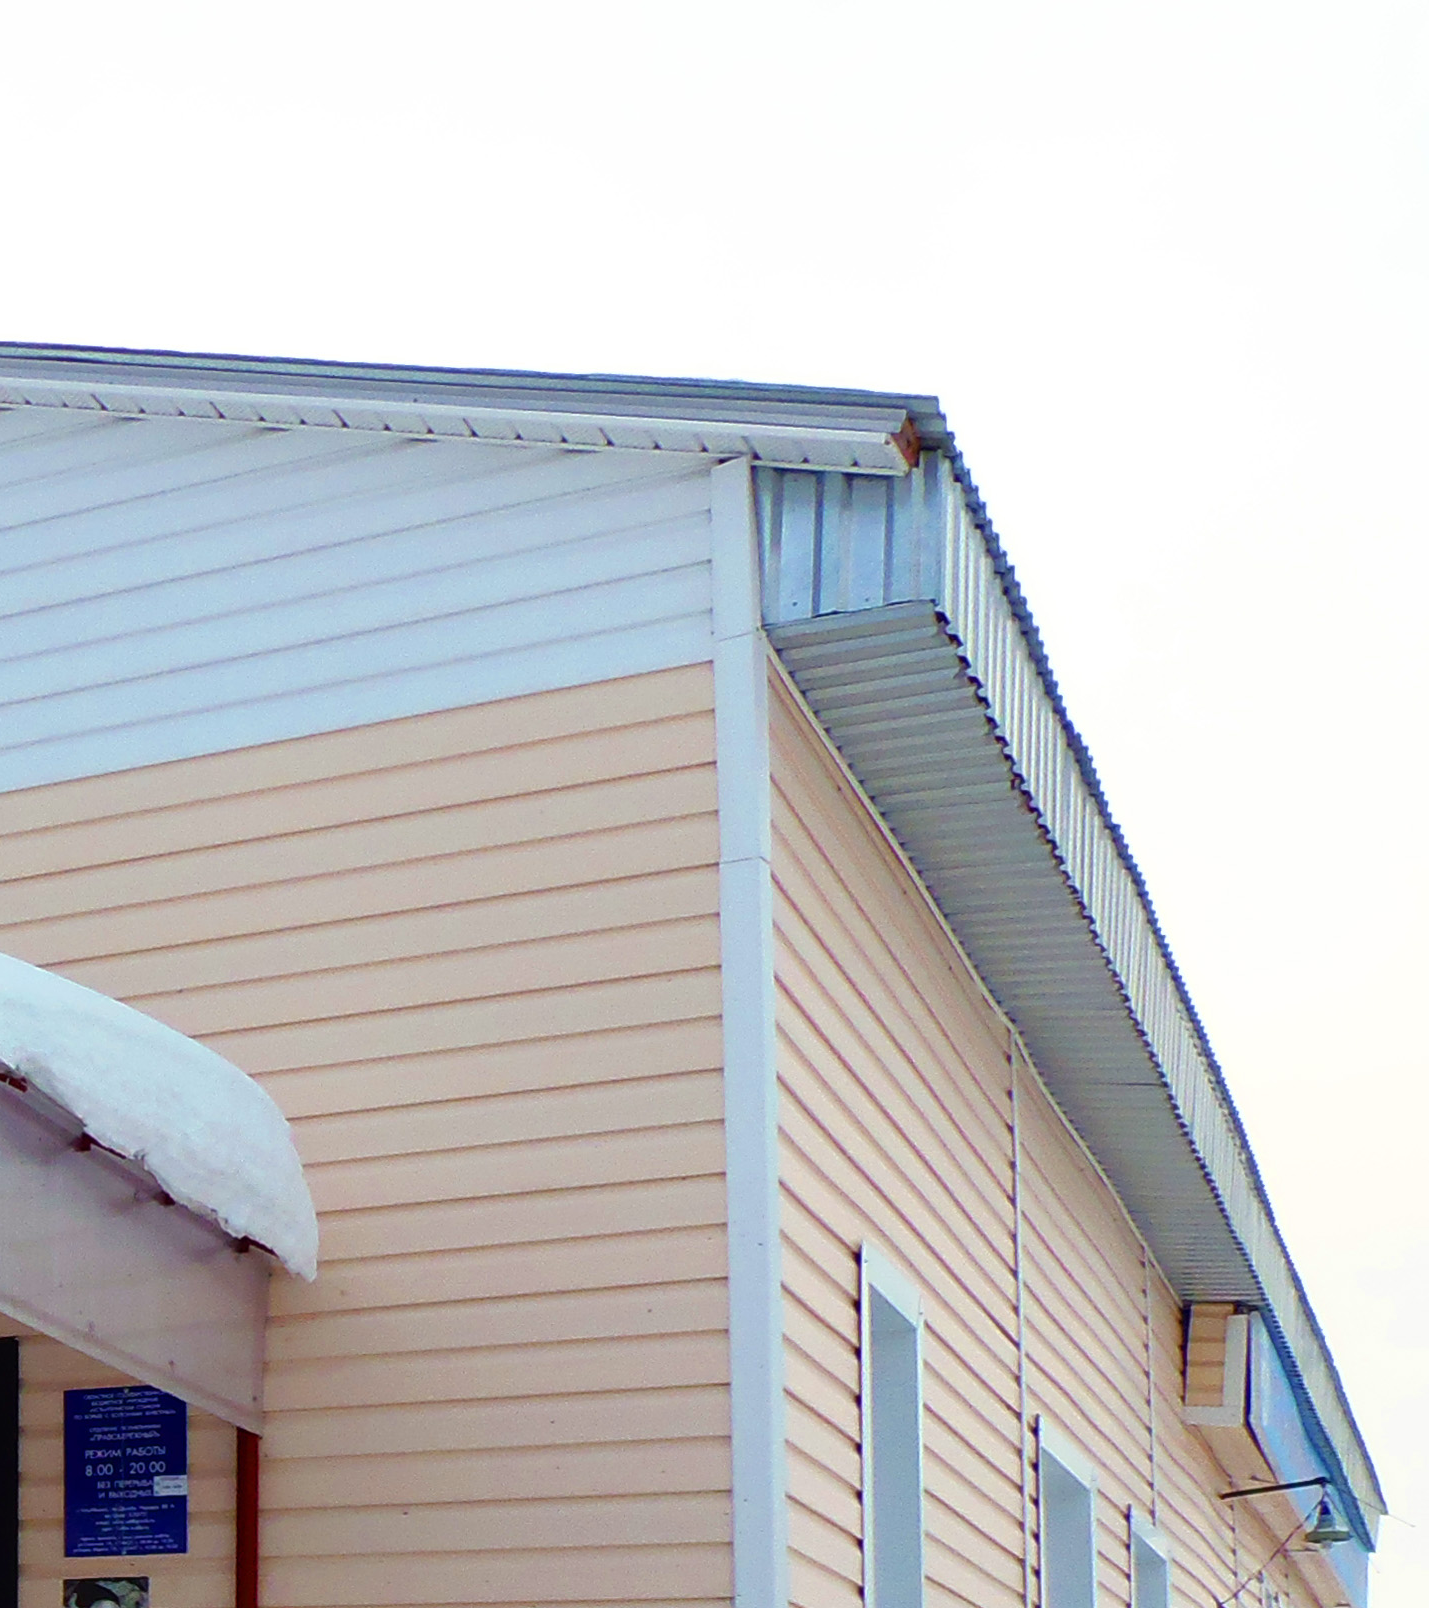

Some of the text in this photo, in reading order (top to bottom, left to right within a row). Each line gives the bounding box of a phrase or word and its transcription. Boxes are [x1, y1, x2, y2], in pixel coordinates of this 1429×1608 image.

[85, 1446, 166, 1459] РЕЖИМ РАБОТЫ
[129, 1461, 166, 1474] 2000
